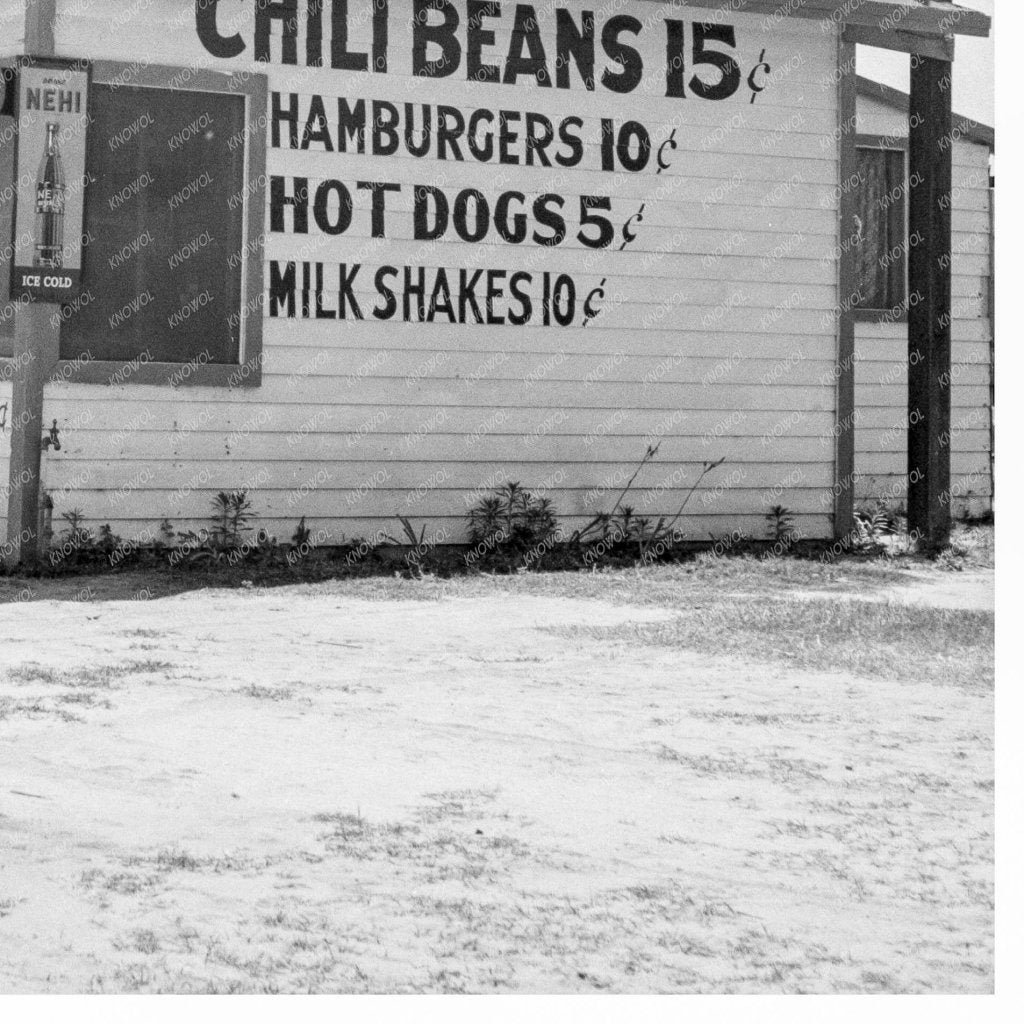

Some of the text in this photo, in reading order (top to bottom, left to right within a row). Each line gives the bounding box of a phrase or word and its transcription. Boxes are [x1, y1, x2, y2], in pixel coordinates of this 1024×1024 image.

[664, 17, 771, 104] 15¢
[26, 87, 81, 113] NEHI
[271, 91, 677, 174] HAMBURGERS 10¢
[270, 175, 645, 250] HOT DOGS 5¢
[22, 275, 72, 288] ICE COLD
[270, 260, 607, 329] MILK SHAKES 10¢
